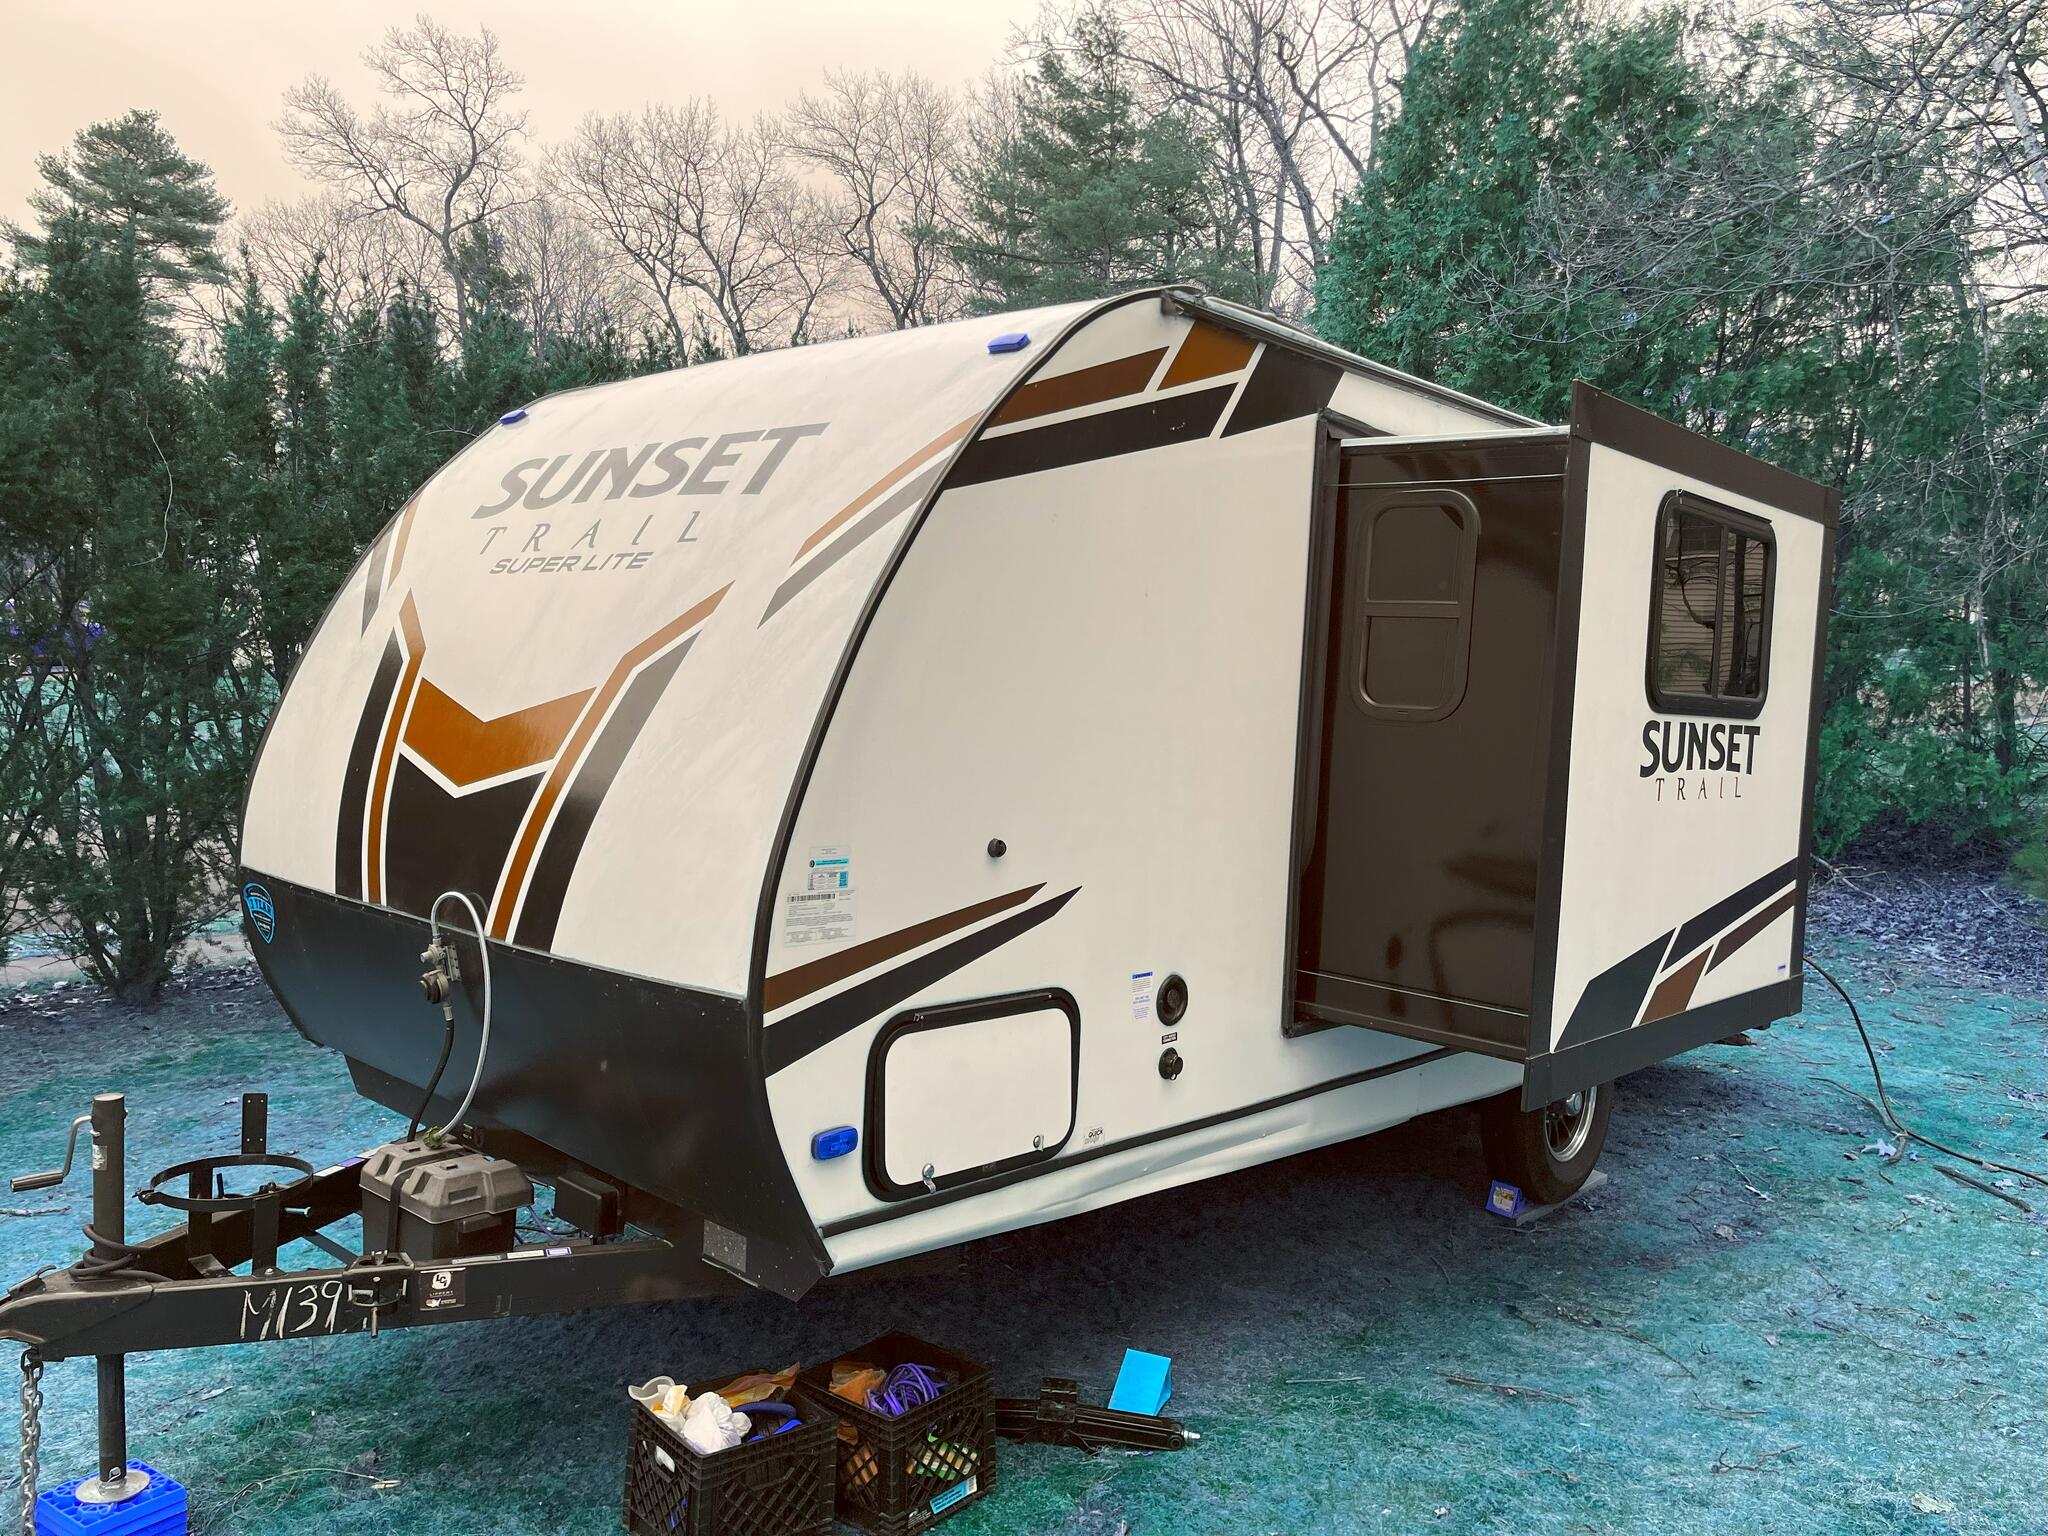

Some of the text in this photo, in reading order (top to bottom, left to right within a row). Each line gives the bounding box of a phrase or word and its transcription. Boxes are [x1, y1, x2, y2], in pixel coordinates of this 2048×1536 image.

[471, 421, 831, 519] SUNSET
[479, 511, 700, 555] TRAIL
[1640, 720, 1760, 778] SUNSET
[1655, 777, 1742, 801] TRAIL
